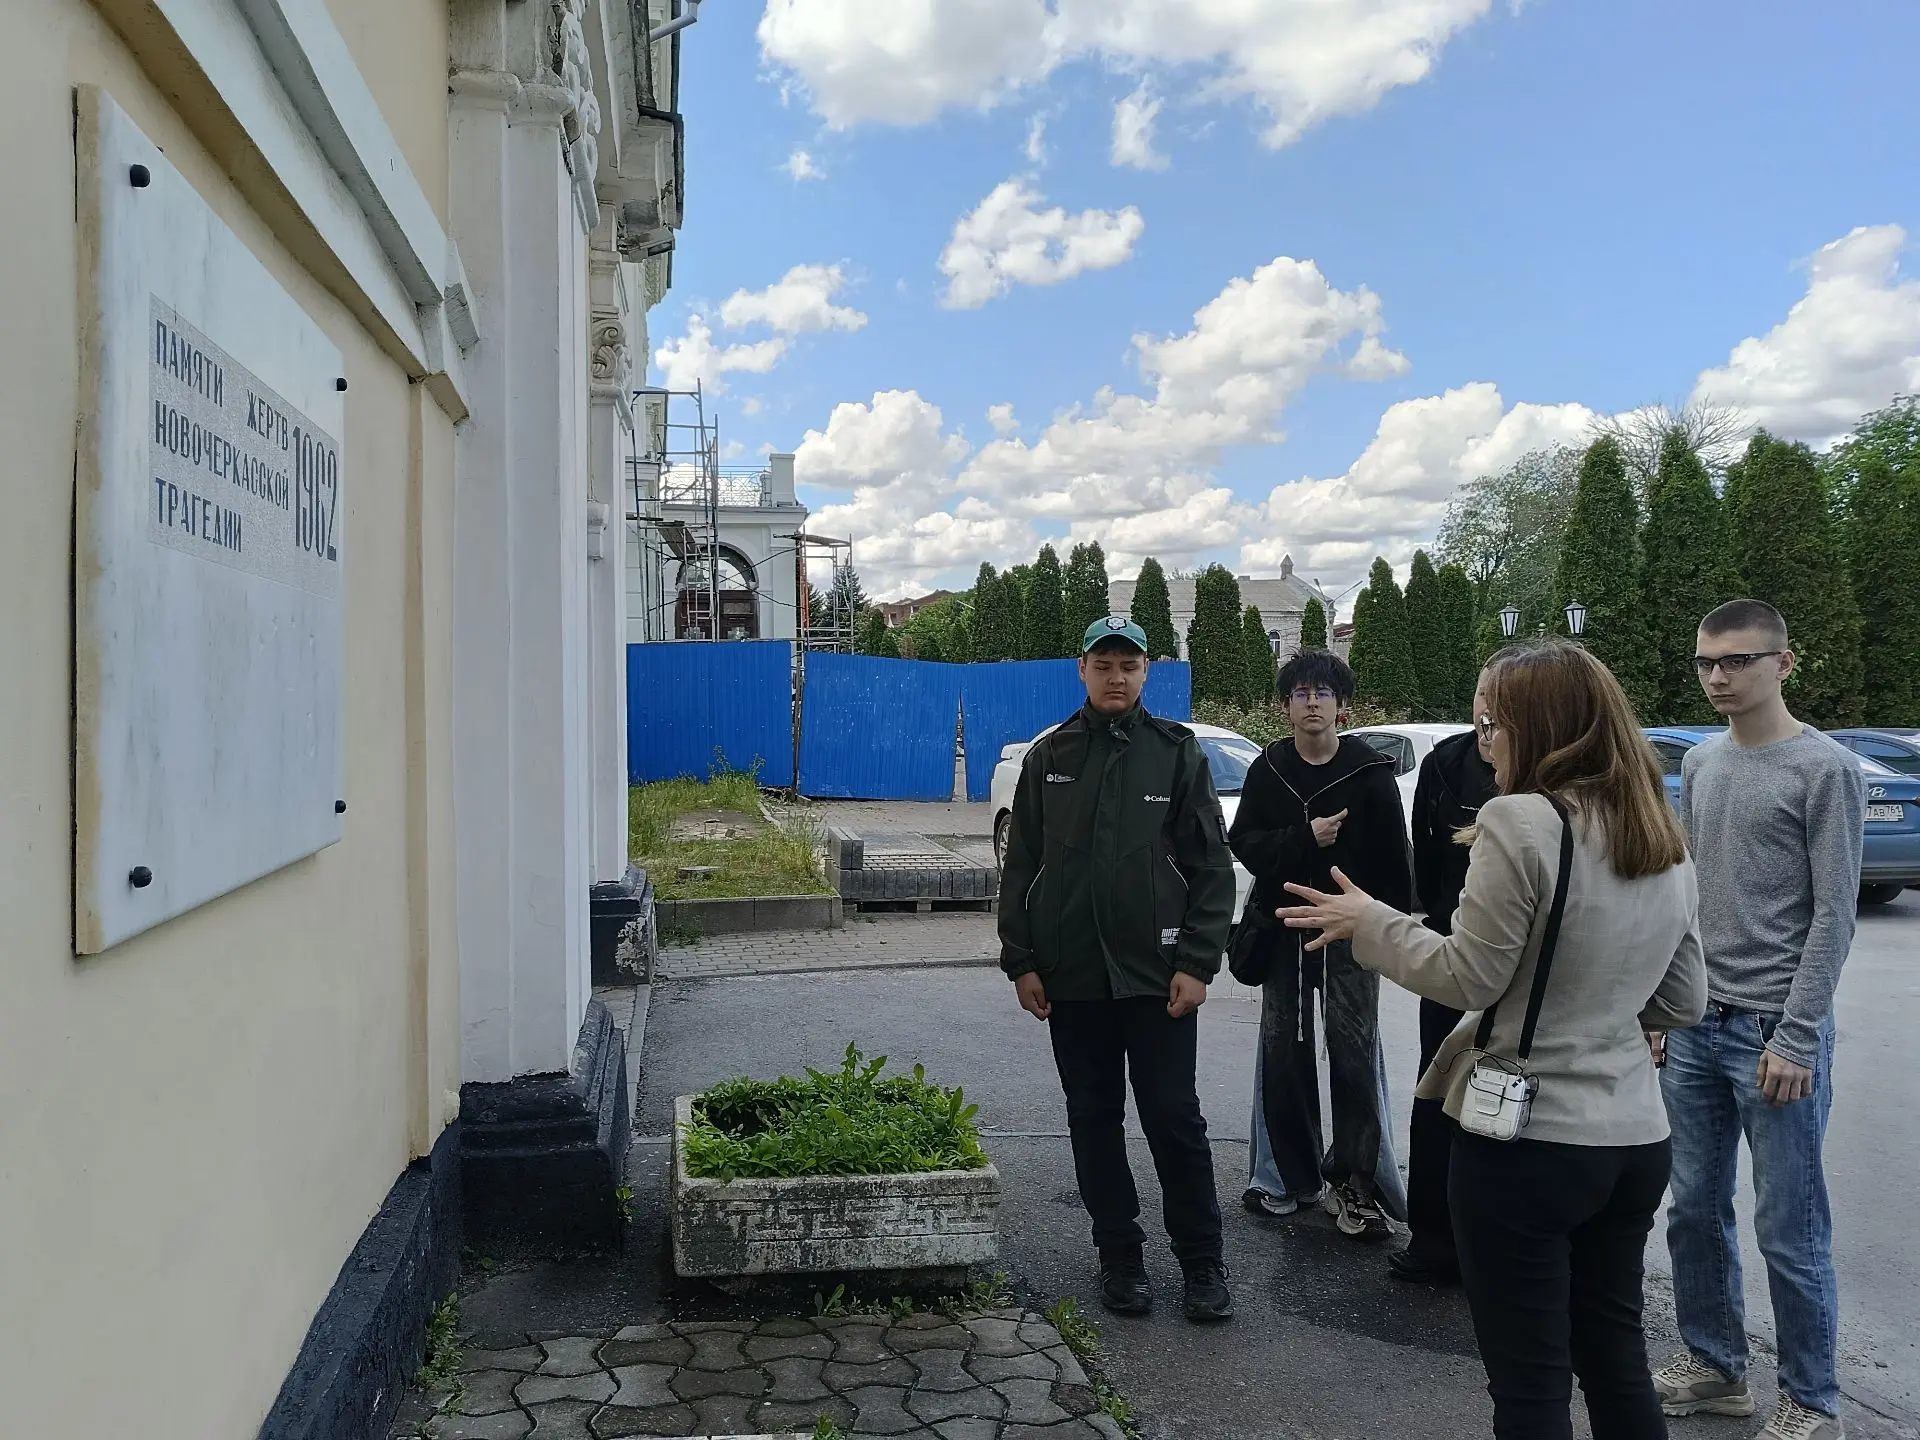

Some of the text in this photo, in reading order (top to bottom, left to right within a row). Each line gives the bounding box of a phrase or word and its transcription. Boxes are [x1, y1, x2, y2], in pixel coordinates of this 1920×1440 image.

[155, 319, 289, 451] ПАМЯТИ ЖЕРТВ
[155, 399, 289, 511] НОВОЧЕРКАССКОЙ
[155, 476, 242, 553] ТРАГЕДИИ
[292, 425, 337, 562] 1962
